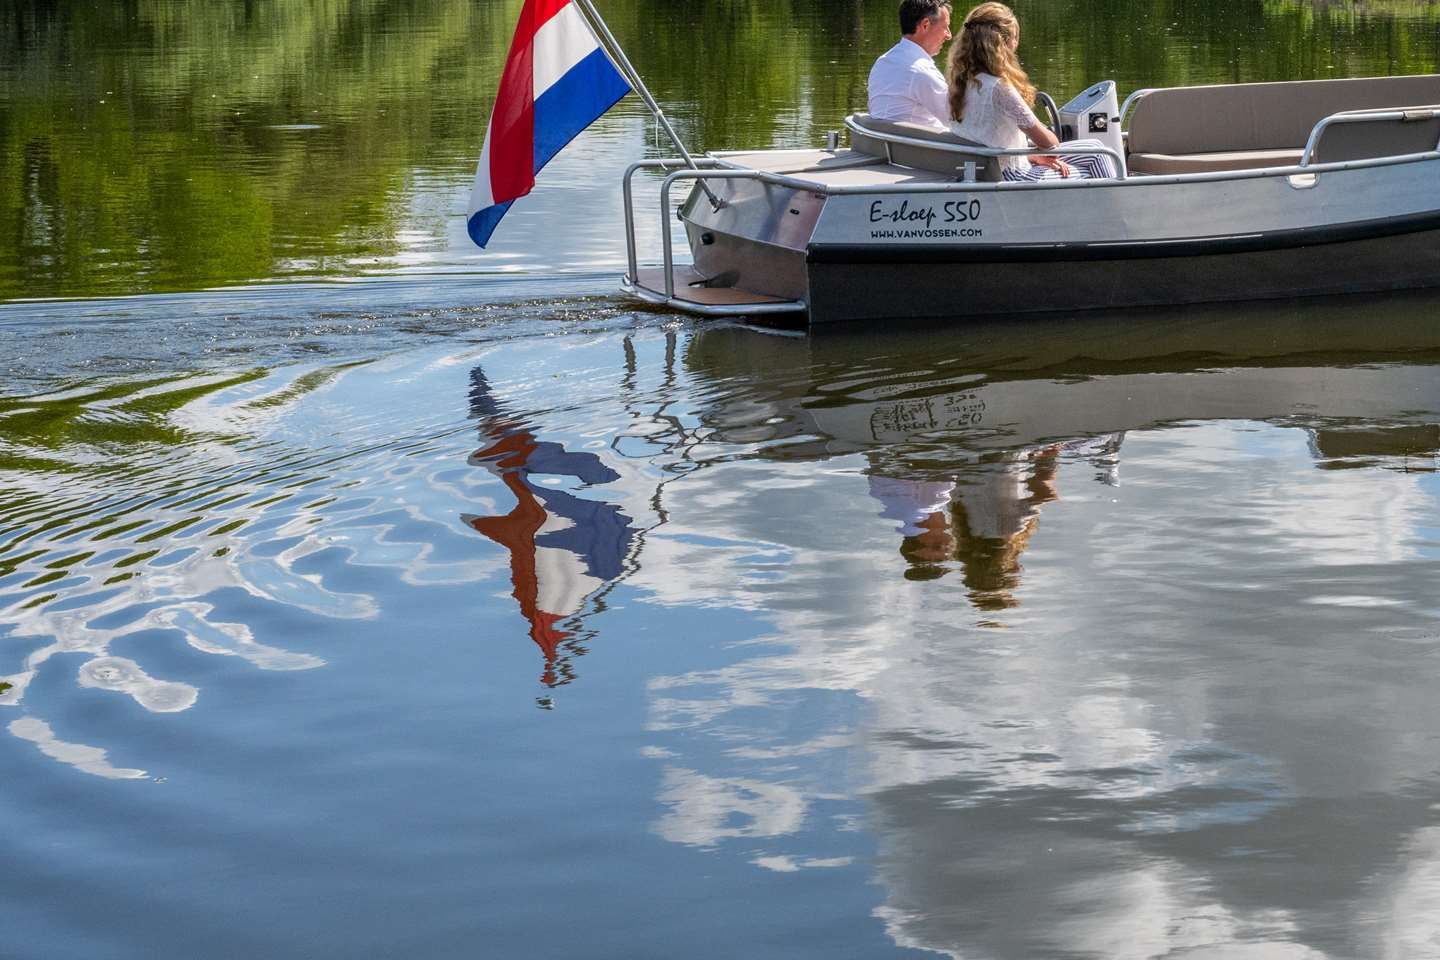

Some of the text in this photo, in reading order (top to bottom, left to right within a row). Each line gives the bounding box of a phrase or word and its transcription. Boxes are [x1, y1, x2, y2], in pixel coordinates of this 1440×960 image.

[870, 199, 981, 227] E-sloep 550
[871, 229, 982, 238] WWW.VANVOSSEN.COM
